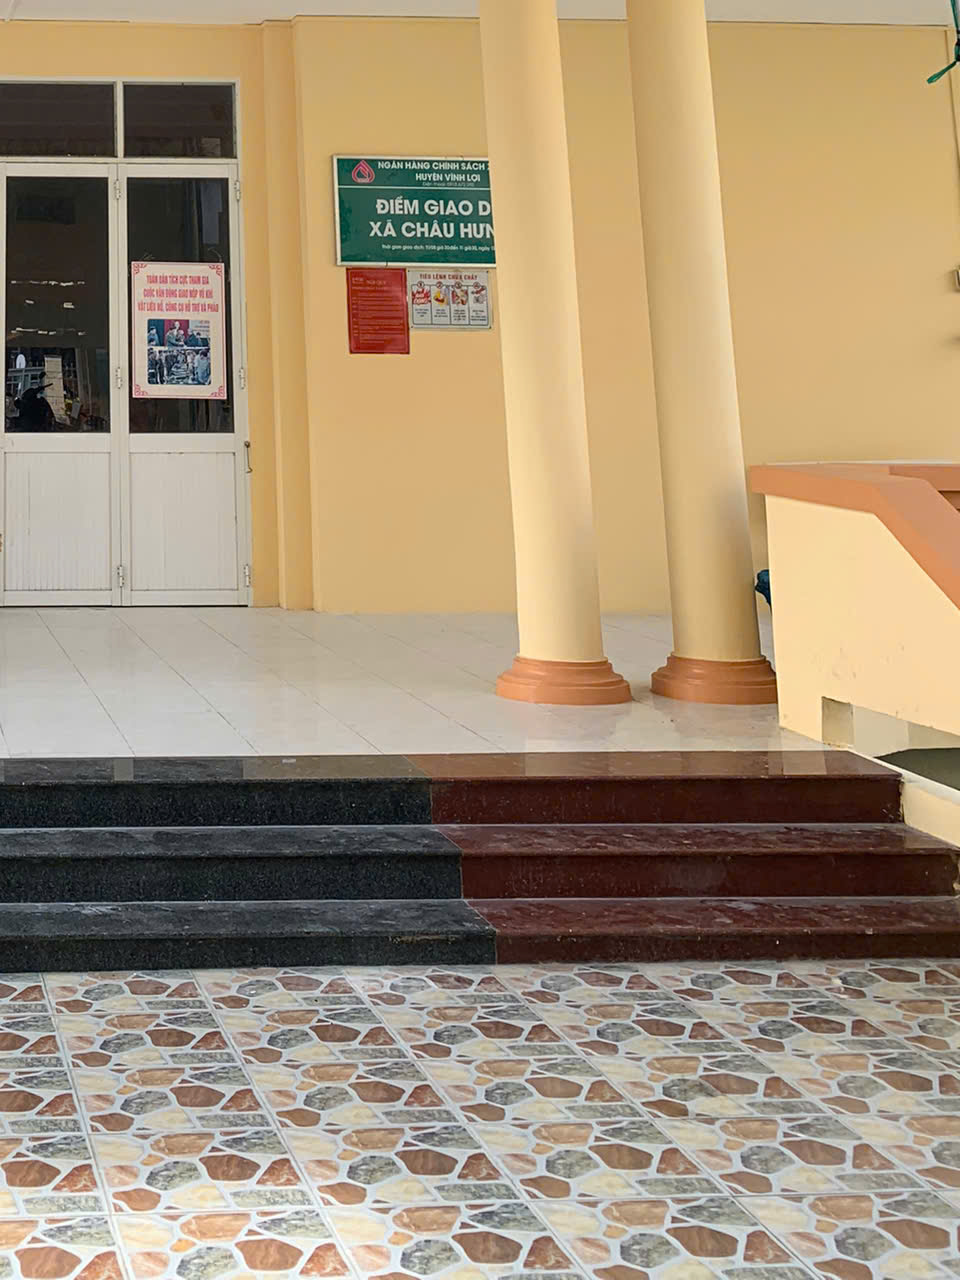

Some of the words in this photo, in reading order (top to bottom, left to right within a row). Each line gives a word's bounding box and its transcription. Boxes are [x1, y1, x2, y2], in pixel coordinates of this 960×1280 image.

[378, 160, 403, 169] NGÂN
[405, 160, 430, 170] HÀNG
[432, 161, 459, 170] CHÍNH
[461, 161, 485, 171] SÁCH
[415, 172, 443, 182] HUYỆN
[445, 172, 465, 182] VĨNH
[467, 173, 480, 182] LỢI
[376, 195, 419, 215] ĐIỂM
[424, 199, 473, 216] GIAO
[478, 200, 491, 216] D
[369, 219, 397, 237] XÃ
[401, 219, 455, 238] CHÂU
[460, 222, 495, 238] HƯN
